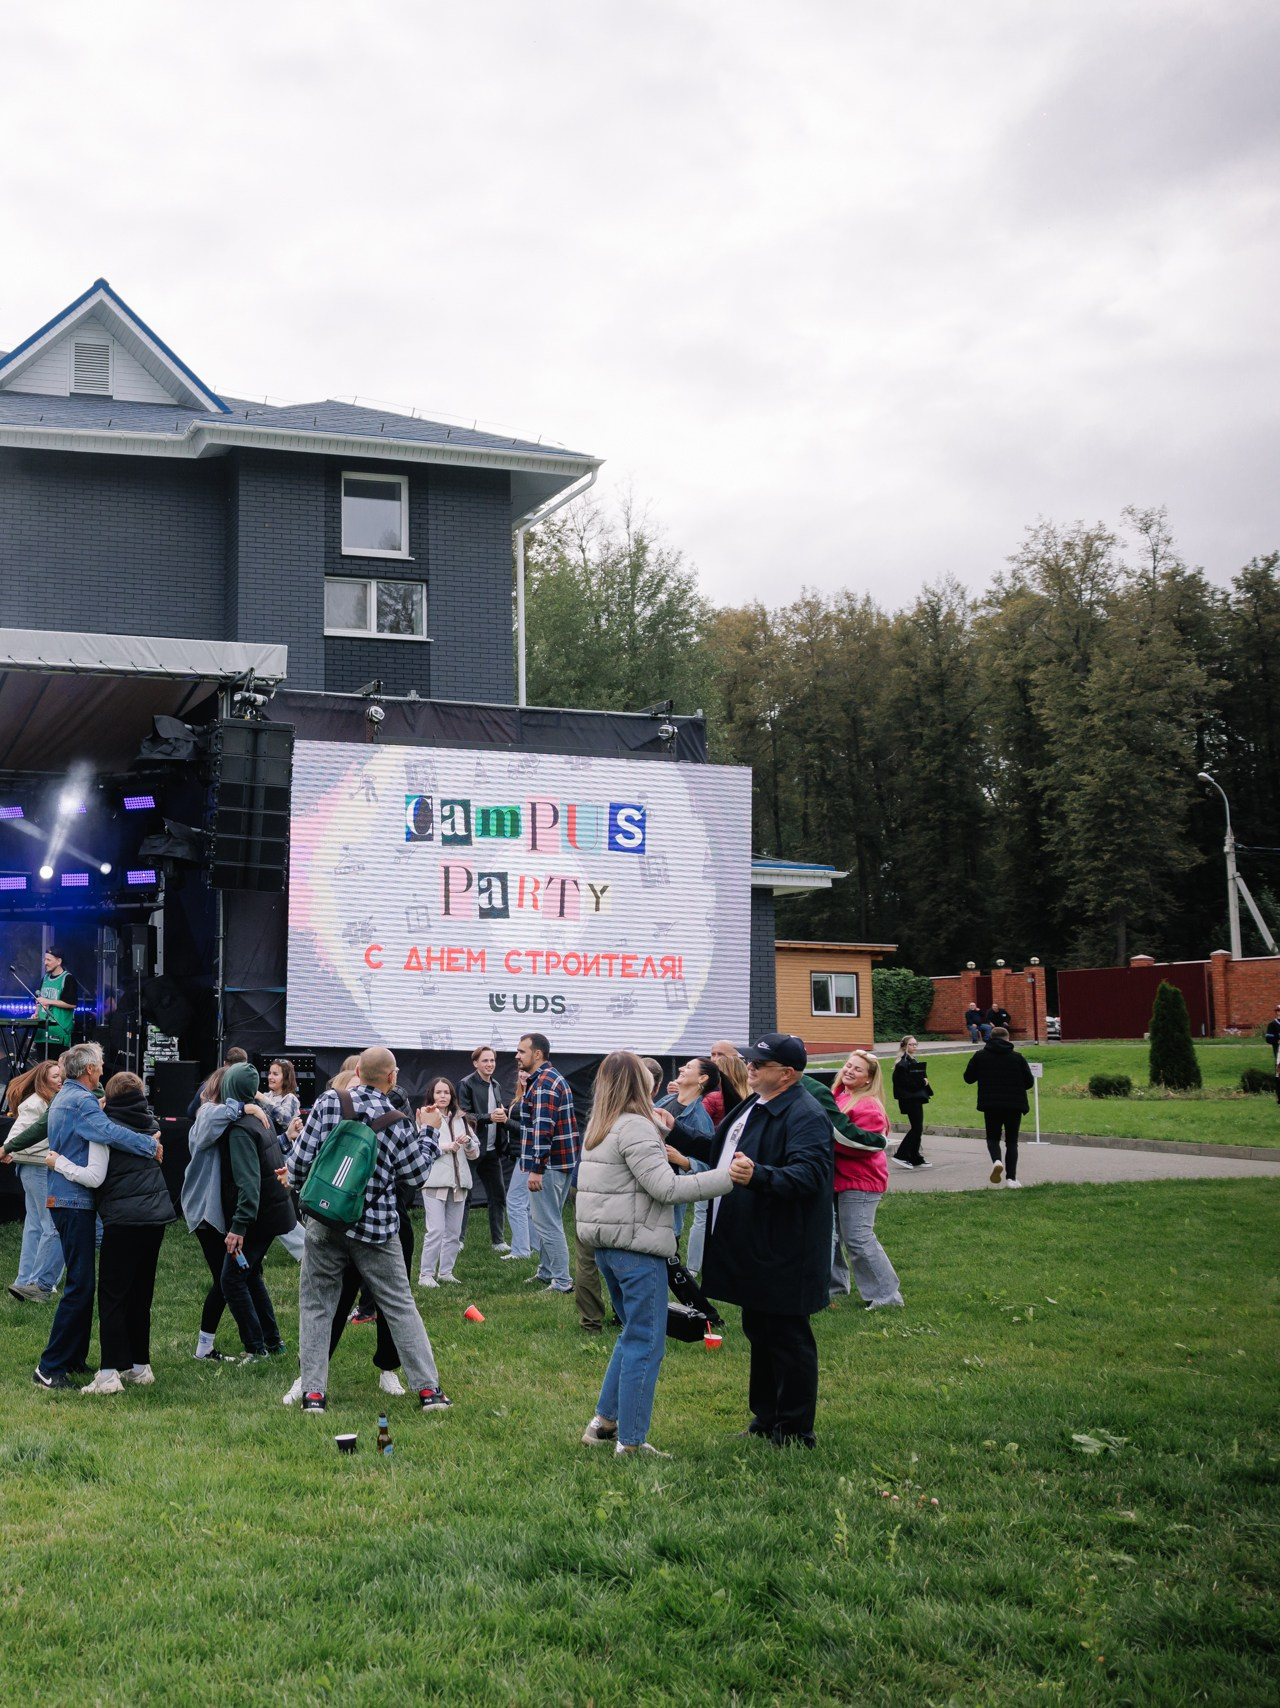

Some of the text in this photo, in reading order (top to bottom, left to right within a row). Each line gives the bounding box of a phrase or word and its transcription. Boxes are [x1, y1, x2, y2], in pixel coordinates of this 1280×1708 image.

[364, 944, 683, 980] С ДНЕМ СТРОИТЕЛЯ!
[512, 994, 567, 1014] UDS
